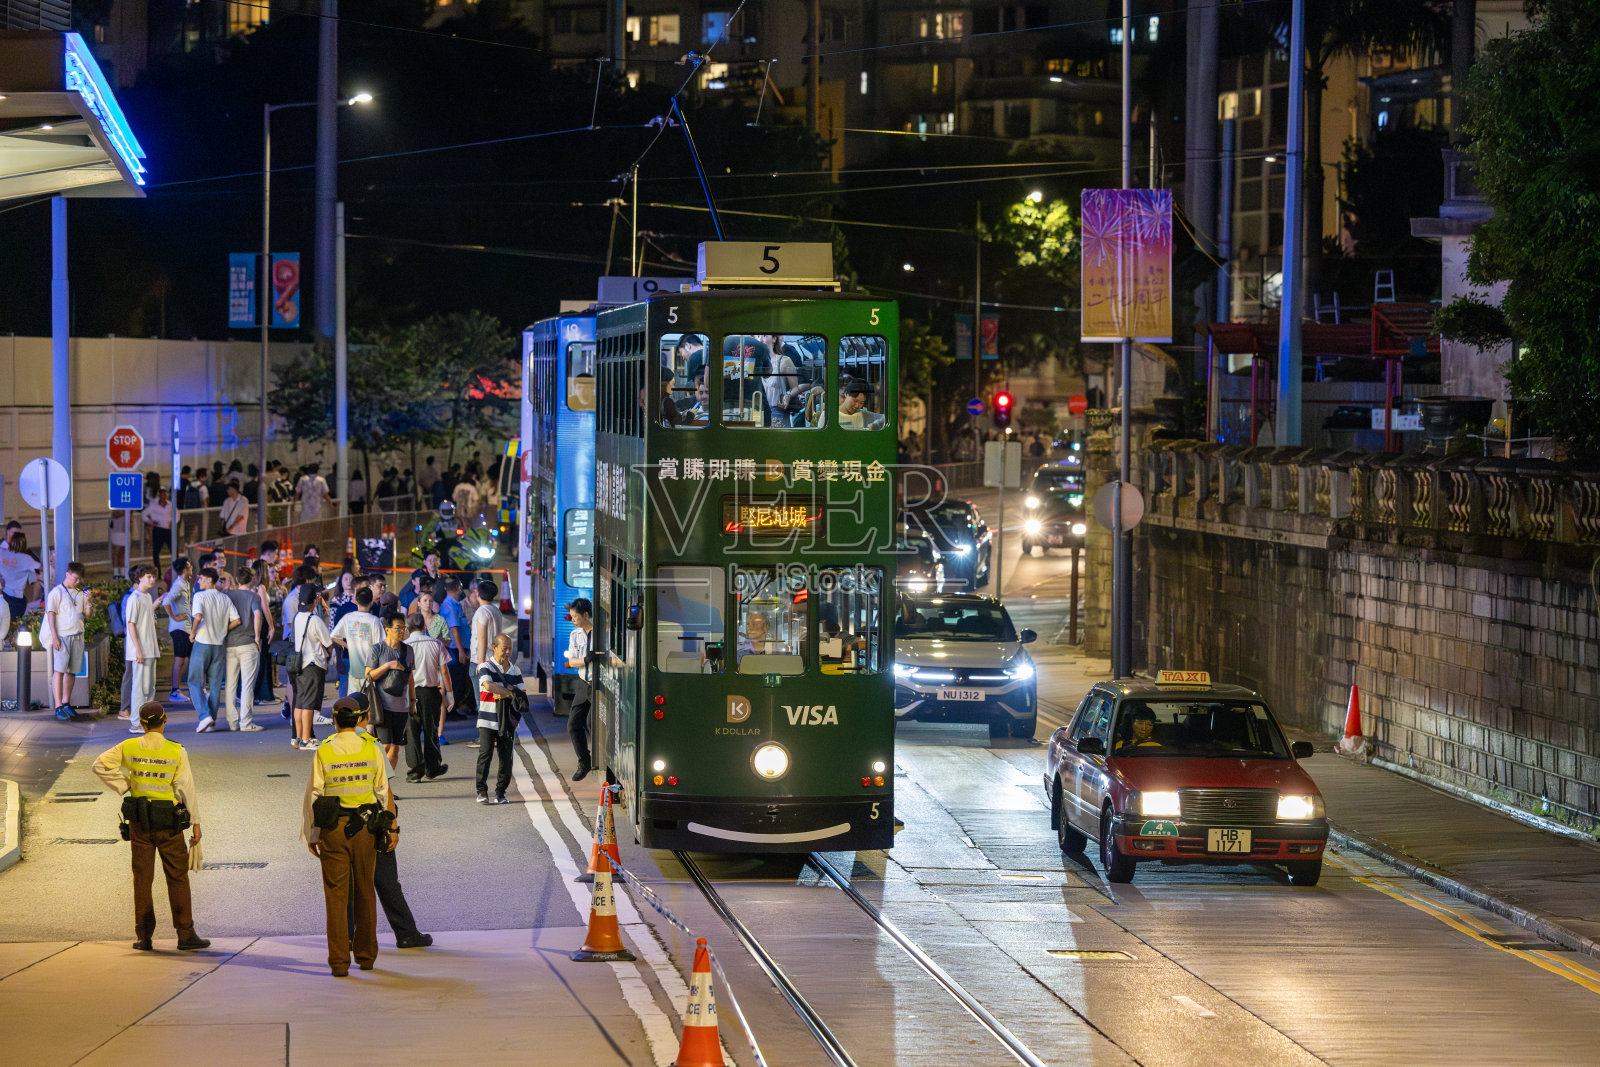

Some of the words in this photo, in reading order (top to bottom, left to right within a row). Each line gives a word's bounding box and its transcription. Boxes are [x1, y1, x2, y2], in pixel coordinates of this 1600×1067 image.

[759, 245, 781, 275] 5
[667, 306, 679, 325] 5
[869, 307, 881, 326] 5
[113, 435, 137, 446] STOP
[120, 450, 131, 463] 停
[658, 457, 757, 481] 賞賺即賺
[792, 458, 886, 482] 賞變現金
[116, 476, 136, 486] OUT
[120, 490, 131, 503] 出
[740, 506, 807, 528] 堅尼地城
[1162, 671, 1207, 683] TAXI
[943, 691, 957, 700] NU
[959, 691, 980, 700] 1312
[780, 705, 839, 726] VISA
[715, 727, 721, 736] K
[722, 727, 761, 736] DOLLAR
[870, 802, 880, 820] 5
[1155, 823, 1164, 831] 4
[1220, 829, 1239, 841] HB
[1215, 840, 1242, 852] 1171
[687, 1003, 701, 1015] CE
